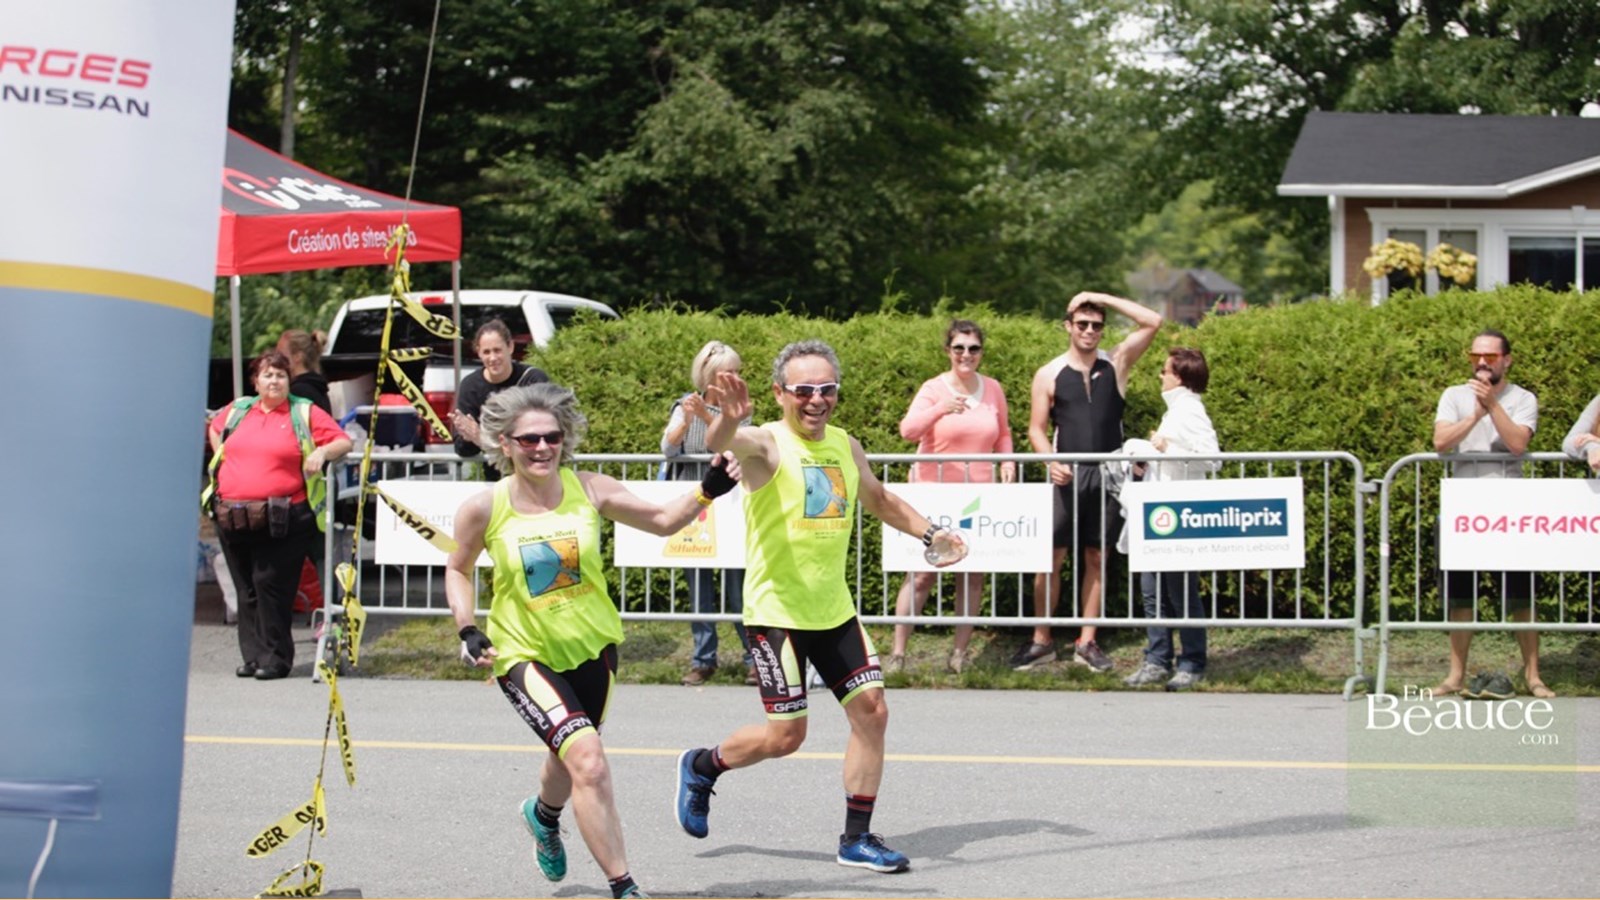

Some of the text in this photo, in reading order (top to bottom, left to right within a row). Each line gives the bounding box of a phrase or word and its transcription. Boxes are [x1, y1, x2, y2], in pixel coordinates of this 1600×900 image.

[0, 45, 152, 89] RGES
[3, 84, 149, 118] NISSAN
[288, 226, 340, 254] Création
[342, 224, 359, 249] de
[362, 225, 388, 248] sites
[978, 515, 1038, 539] Profil
[1180, 506, 1283, 533] familiprix
[1143, 541, 1290, 556] Denis Roy et Martin Leblond
[752, 648, 773, 688] QUÉBEC
[761, 640, 787, 695] GARNEAU
[506, 681, 550, 731] GARNEAU
